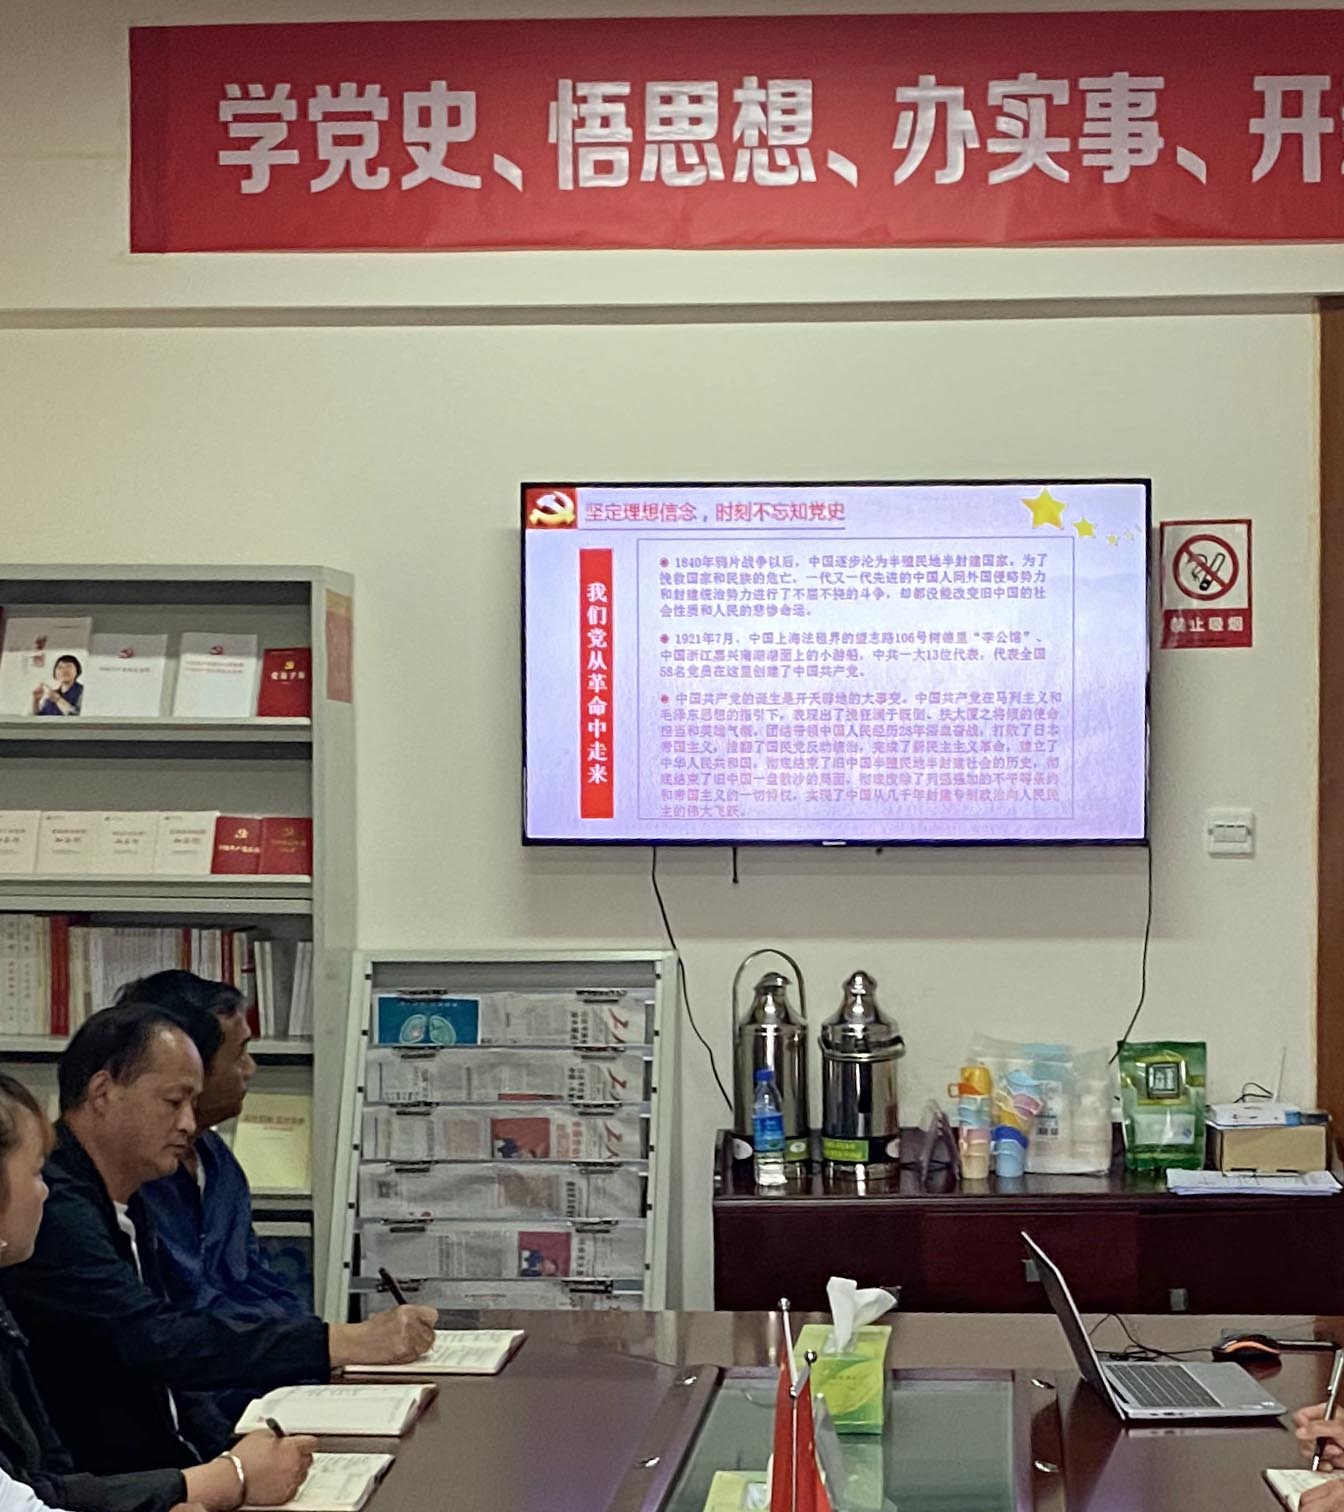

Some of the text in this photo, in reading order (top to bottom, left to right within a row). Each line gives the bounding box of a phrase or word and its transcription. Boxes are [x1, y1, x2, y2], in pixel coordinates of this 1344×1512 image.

[585, 502, 846, 522] 坚定理想信念，时刻不忘知党史
[1169, 615, 1244, 634] 禁止吸烟
[586, 582, 608, 784] 我们党从革命中走来
